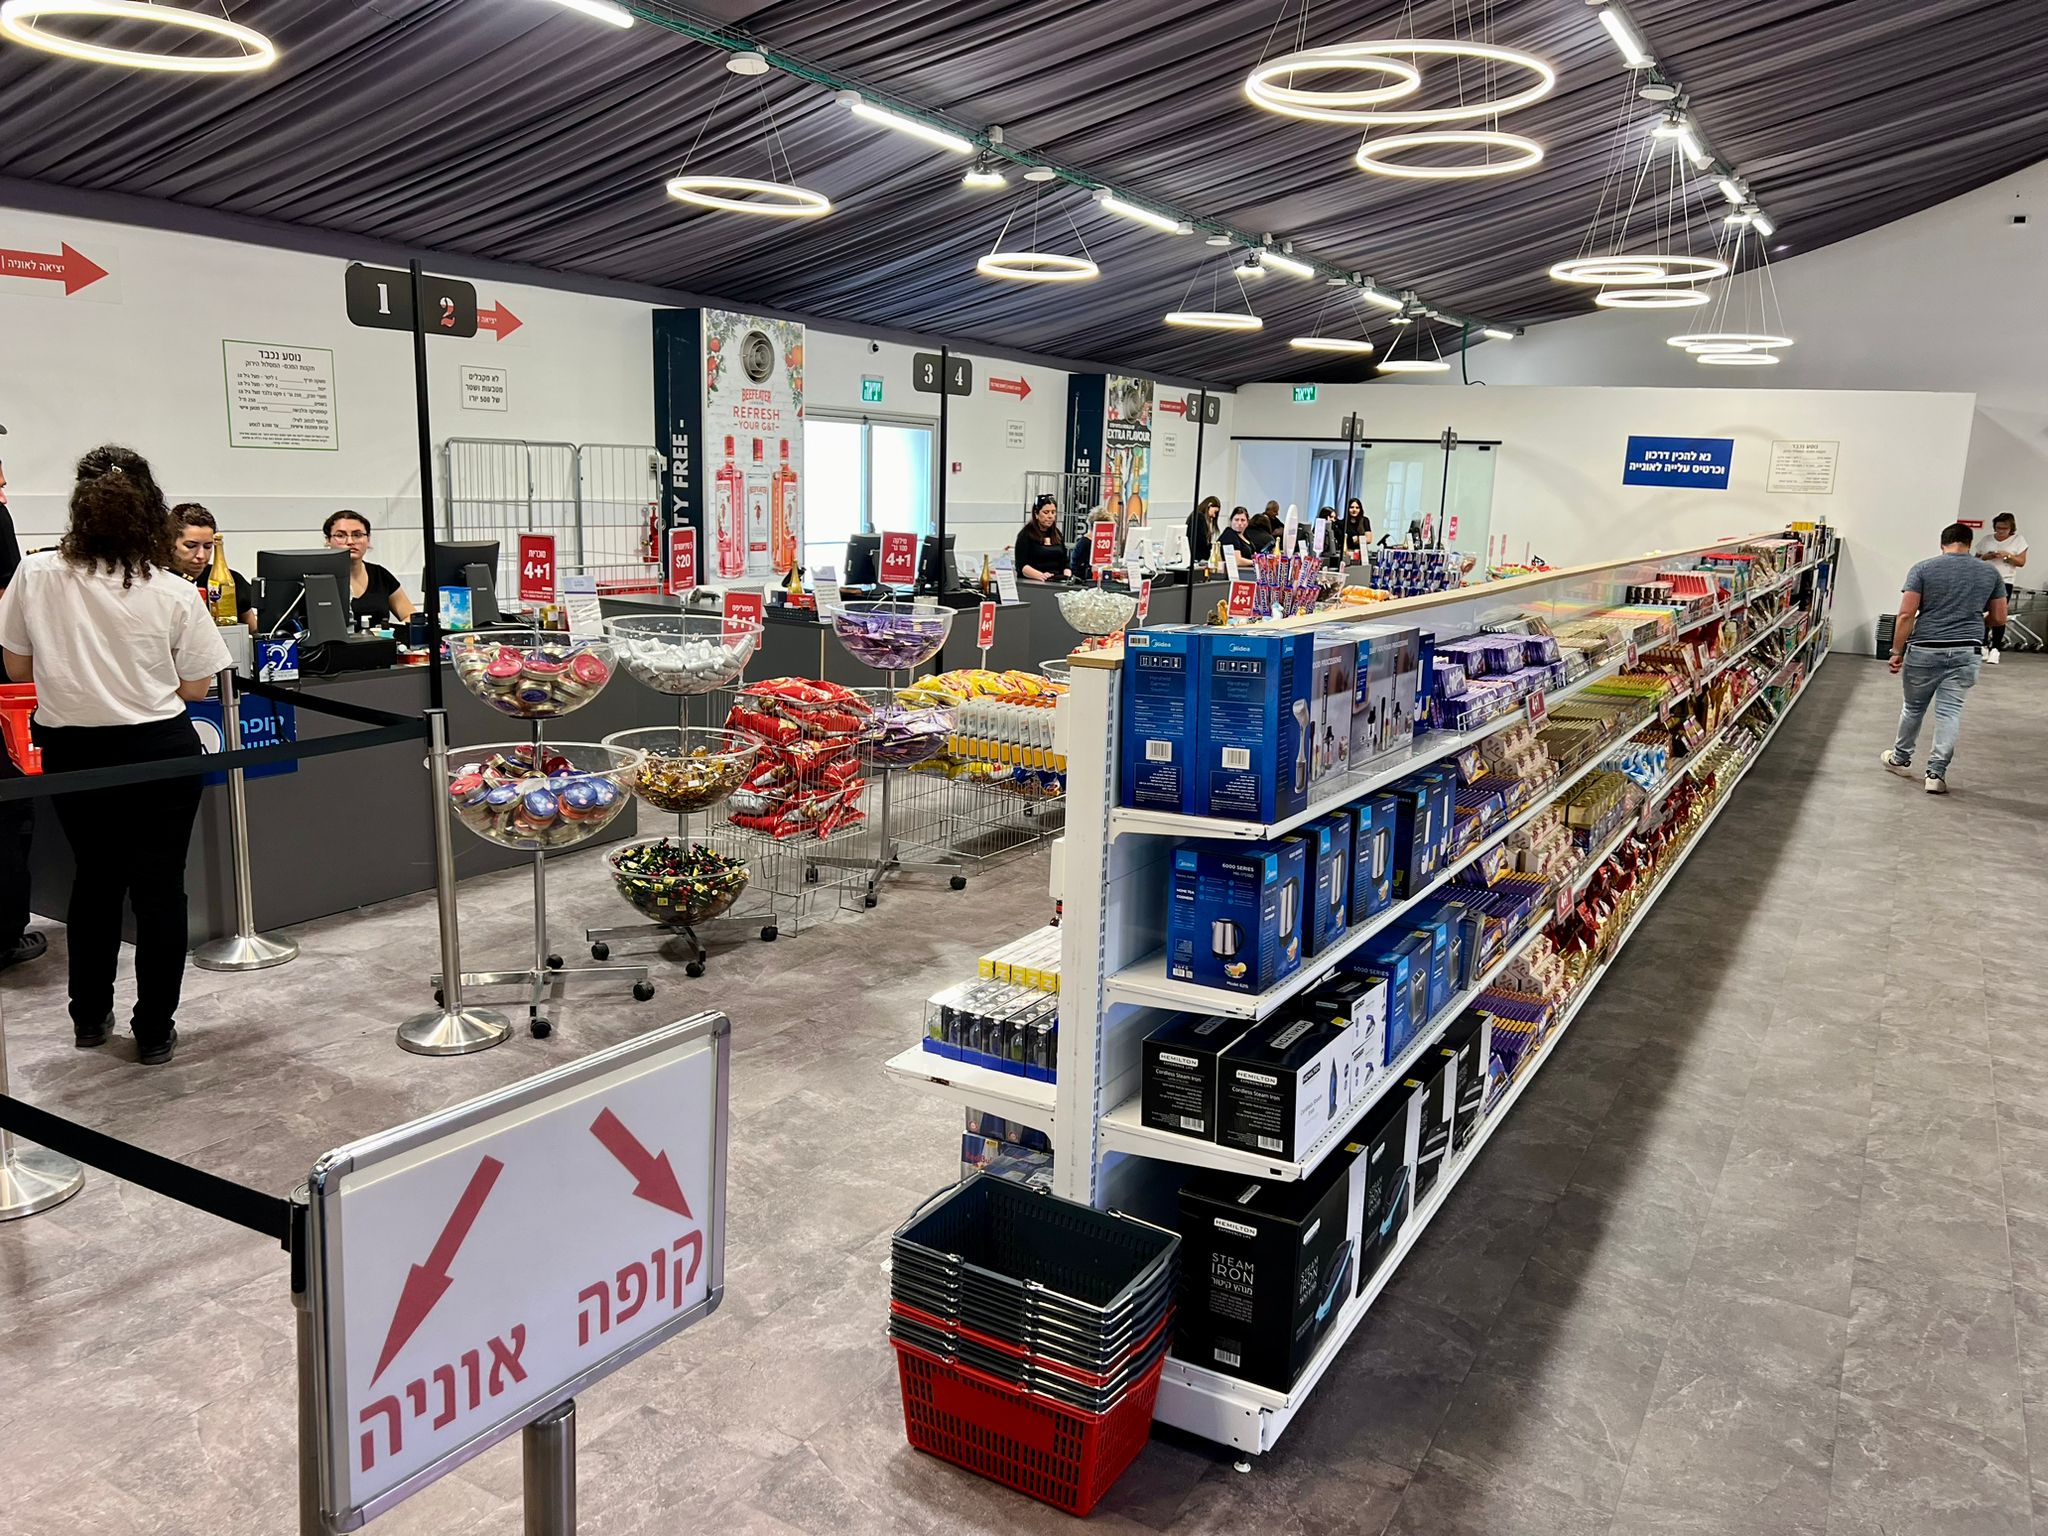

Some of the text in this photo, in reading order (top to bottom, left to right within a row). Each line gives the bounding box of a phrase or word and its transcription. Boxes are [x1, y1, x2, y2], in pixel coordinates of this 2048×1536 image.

[8, 259, 65, 272] יציאה לאוניה
[377, 283, 456, 328] 1 2
[258, 350, 302, 362] נוסע נכבד
[924, 363, 963, 386] 3 4
[733, 406, 780, 420] REFRESH
[1208, 402, 1215, 418] 6
[1108, 429, 1150, 442] EXTRA FLAVOUR
[672, 434, 689, 488] FREE
[1645, 450, 1712, 462] נא להכין דרכון
[1629, 462, 1726, 474] וכרטיס עלייה לאונייה
[673, 494, 690, 527] TY
[1096, 540, 1110, 550] $20
[676, 554, 690, 568] $20
[886, 552, 912, 568] 4+1
[524, 561, 550, 580] 4+1
[1233, 595, 1251, 606] 4+1
[982, 620, 992, 632] 4+1
[1353, 966, 1390, 977] 5000 SERIES
[1160, 1054, 1197, 1066] HEMILTON
[1156, 1068, 1176, 1078] Cordless
[1176, 1072, 1191, 1080] Steam
[1237, 1071, 1276, 1084] HEMILTON
[1232, 1086, 1253, 1096] Cordless
[1254, 1090, 1269, 1100] Steam
[1215, 1219, 1256, 1236] HEMILTON
[1212, 1252, 1254, 1273] STEAM
[1212, 1262, 1254, 1286] IRON
[577, 1228, 704, 1348] קופה
[1210, 1276, 1232, 1290] קיטור
[359, 1323, 528, 1472] אוניה
